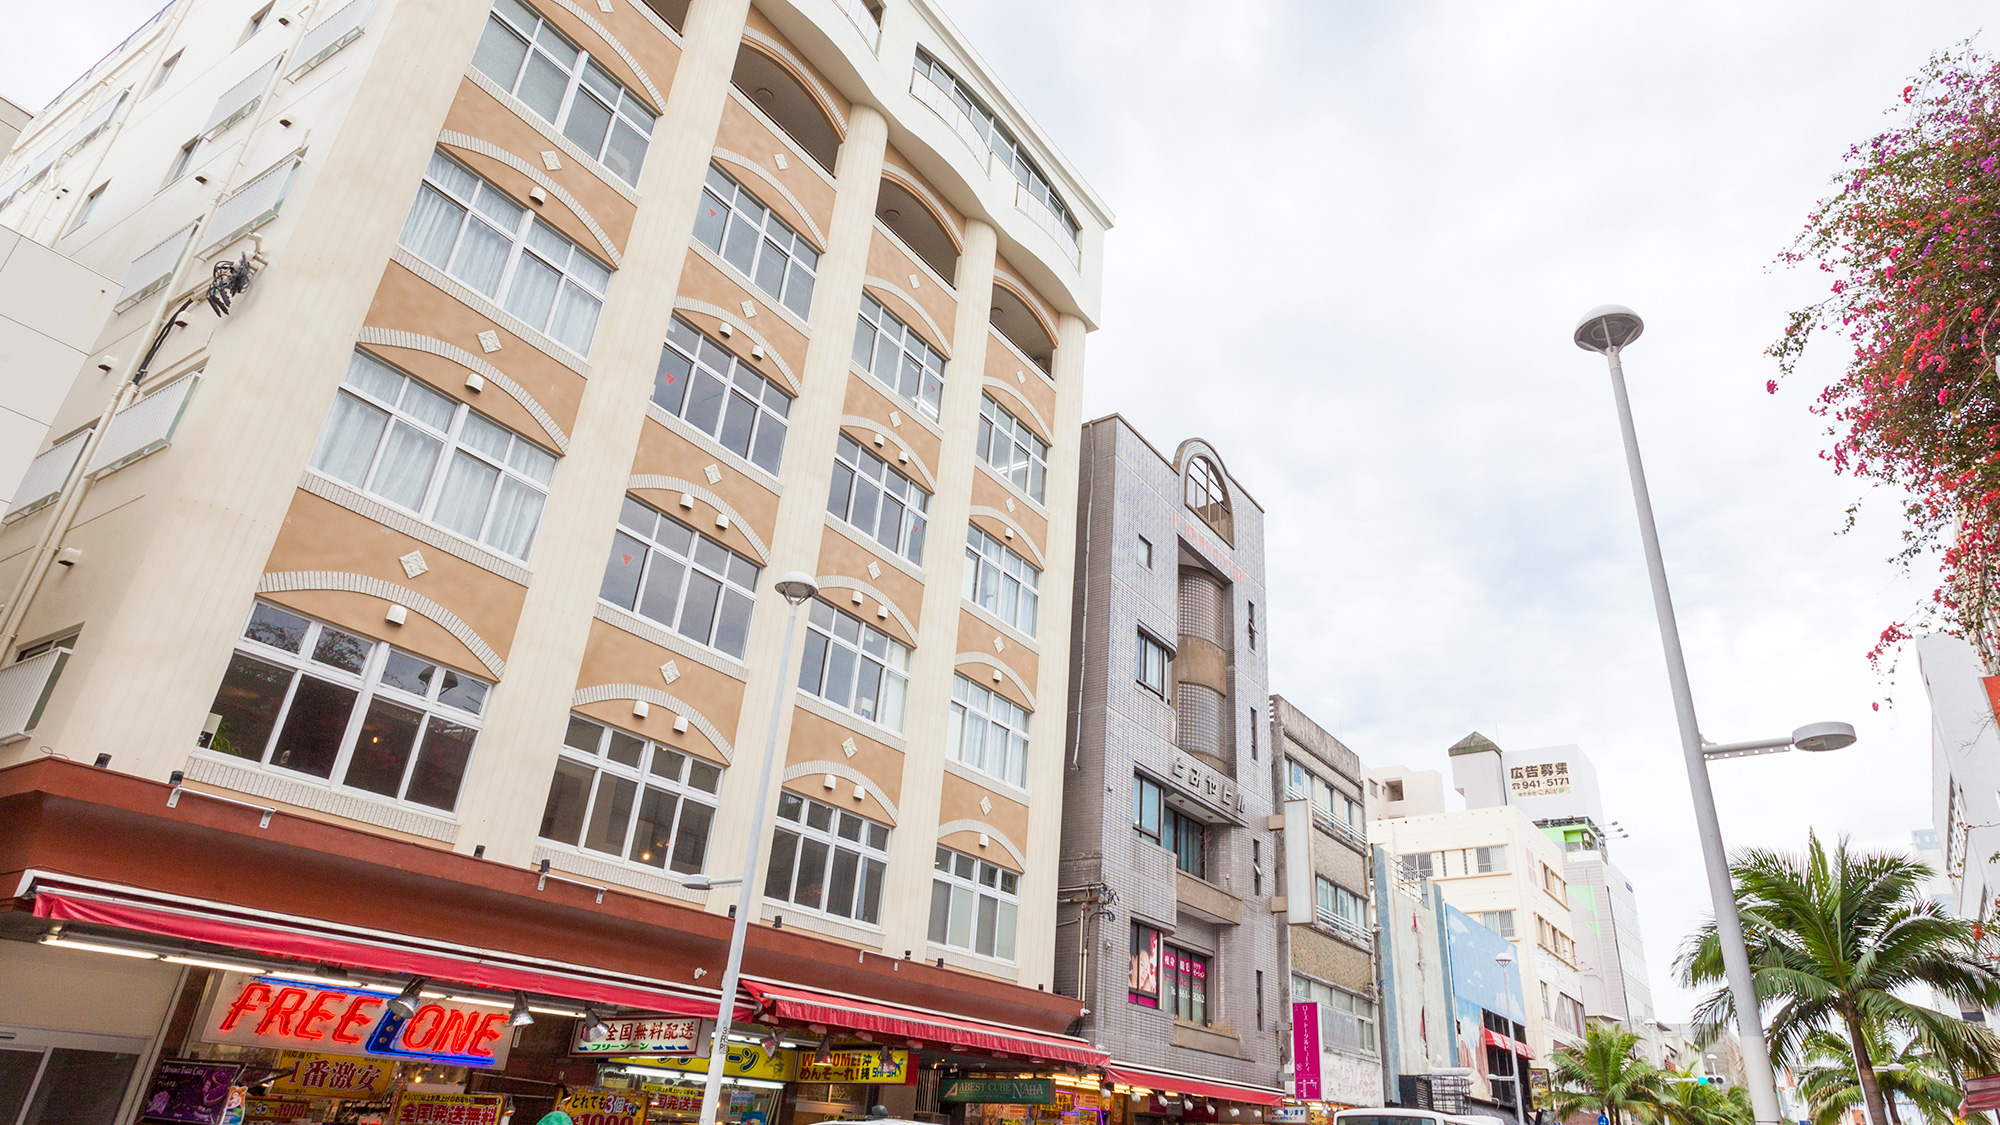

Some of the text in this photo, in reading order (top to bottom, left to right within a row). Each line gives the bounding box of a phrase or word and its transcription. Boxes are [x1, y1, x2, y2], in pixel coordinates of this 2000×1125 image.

[1510, 762, 1568, 779] 広告募集
[219, 982, 384, 1044] FREE
[591, 1042, 650, 1051] フリーゾーン
[802, 1053, 861, 1067] WOME!
[287, 1059, 382, 1093] 1番激安
[958, 1082, 985, 1092] ABEST
[987, 1083, 1012, 1092] CUBE
[1012, 1083, 1044, 1099] NAHA
[400, 1102, 499, 1125] 全国発送無料
